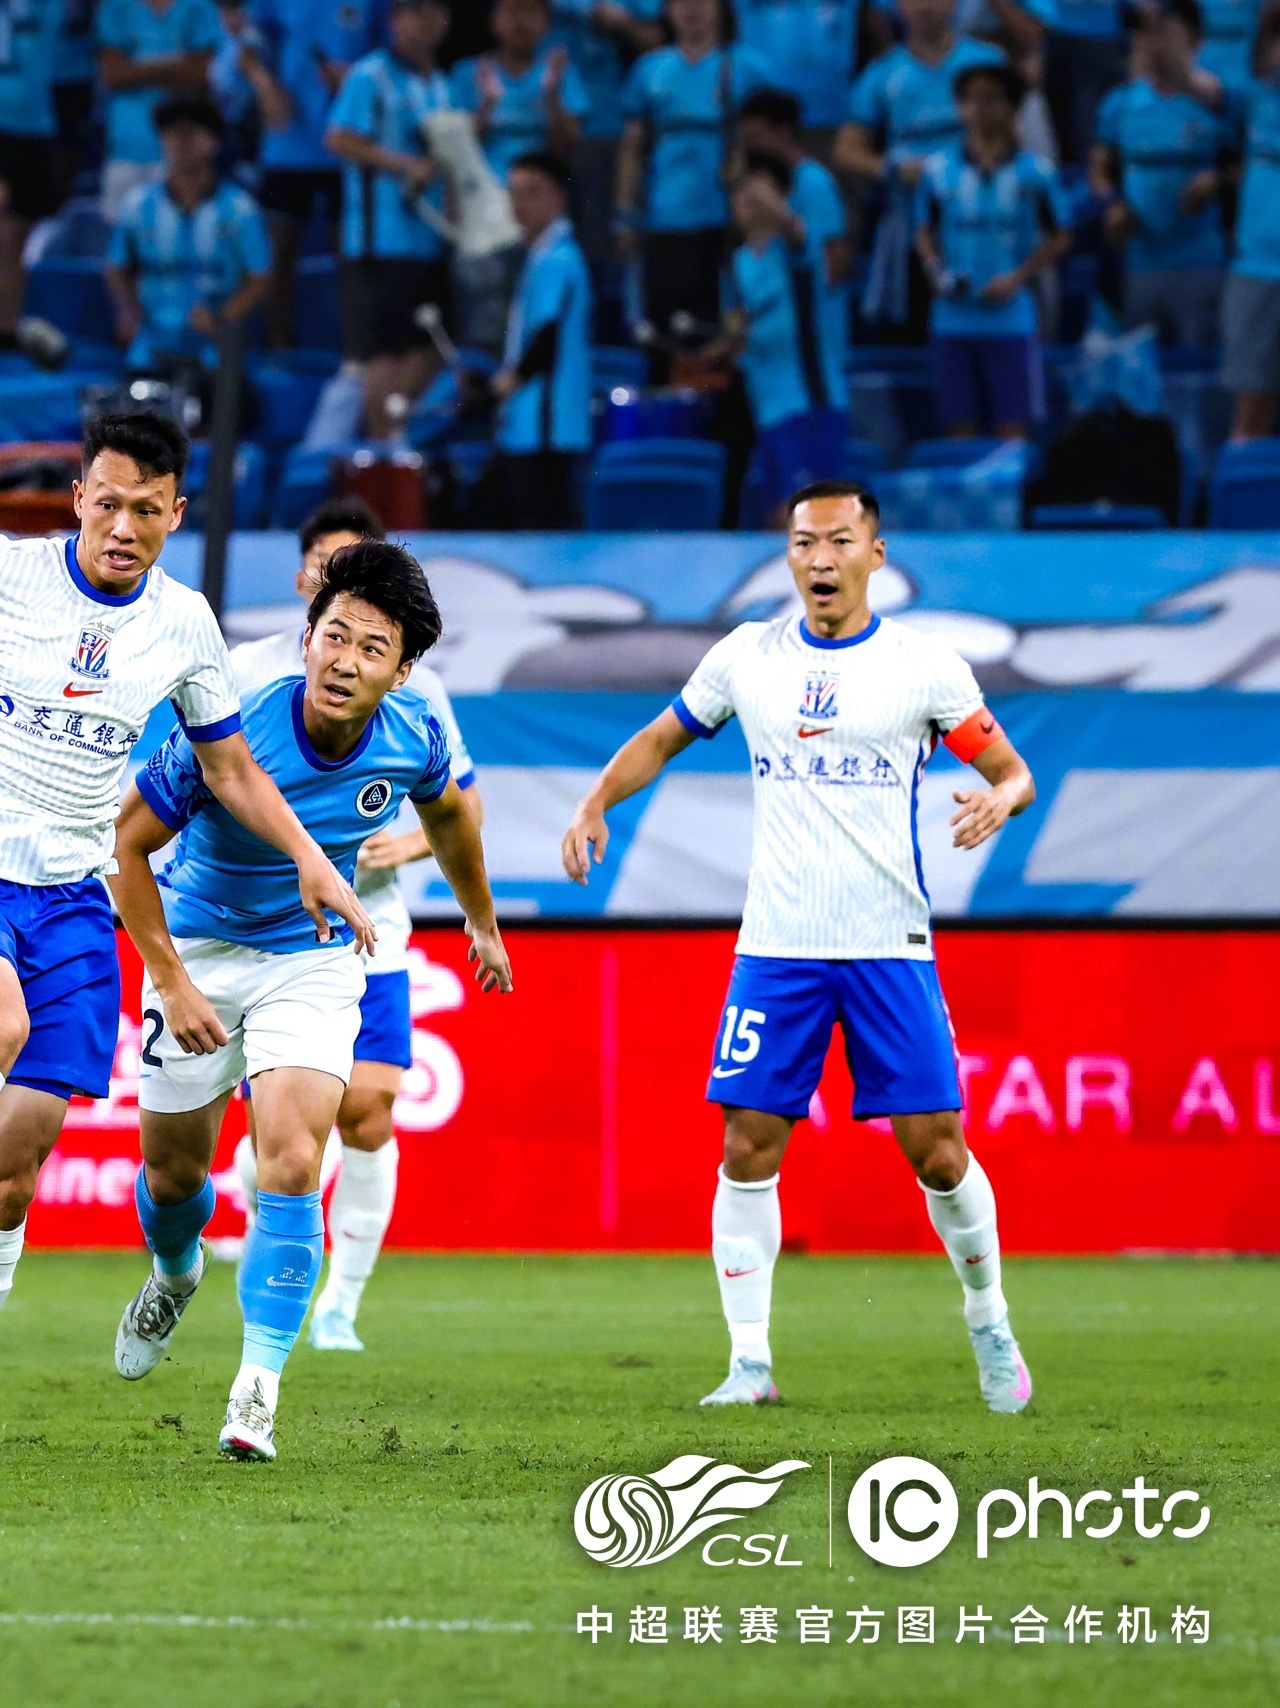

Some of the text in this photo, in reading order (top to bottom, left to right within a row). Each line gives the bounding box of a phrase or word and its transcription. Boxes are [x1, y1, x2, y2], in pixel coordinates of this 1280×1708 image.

[14, 721, 44, 737] BANK
[49, 733, 65, 742] OF
[140, 1009, 164, 1068] 2
[720, 1005, 766, 1063] 15
[279, 1266, 308, 1283] 22
